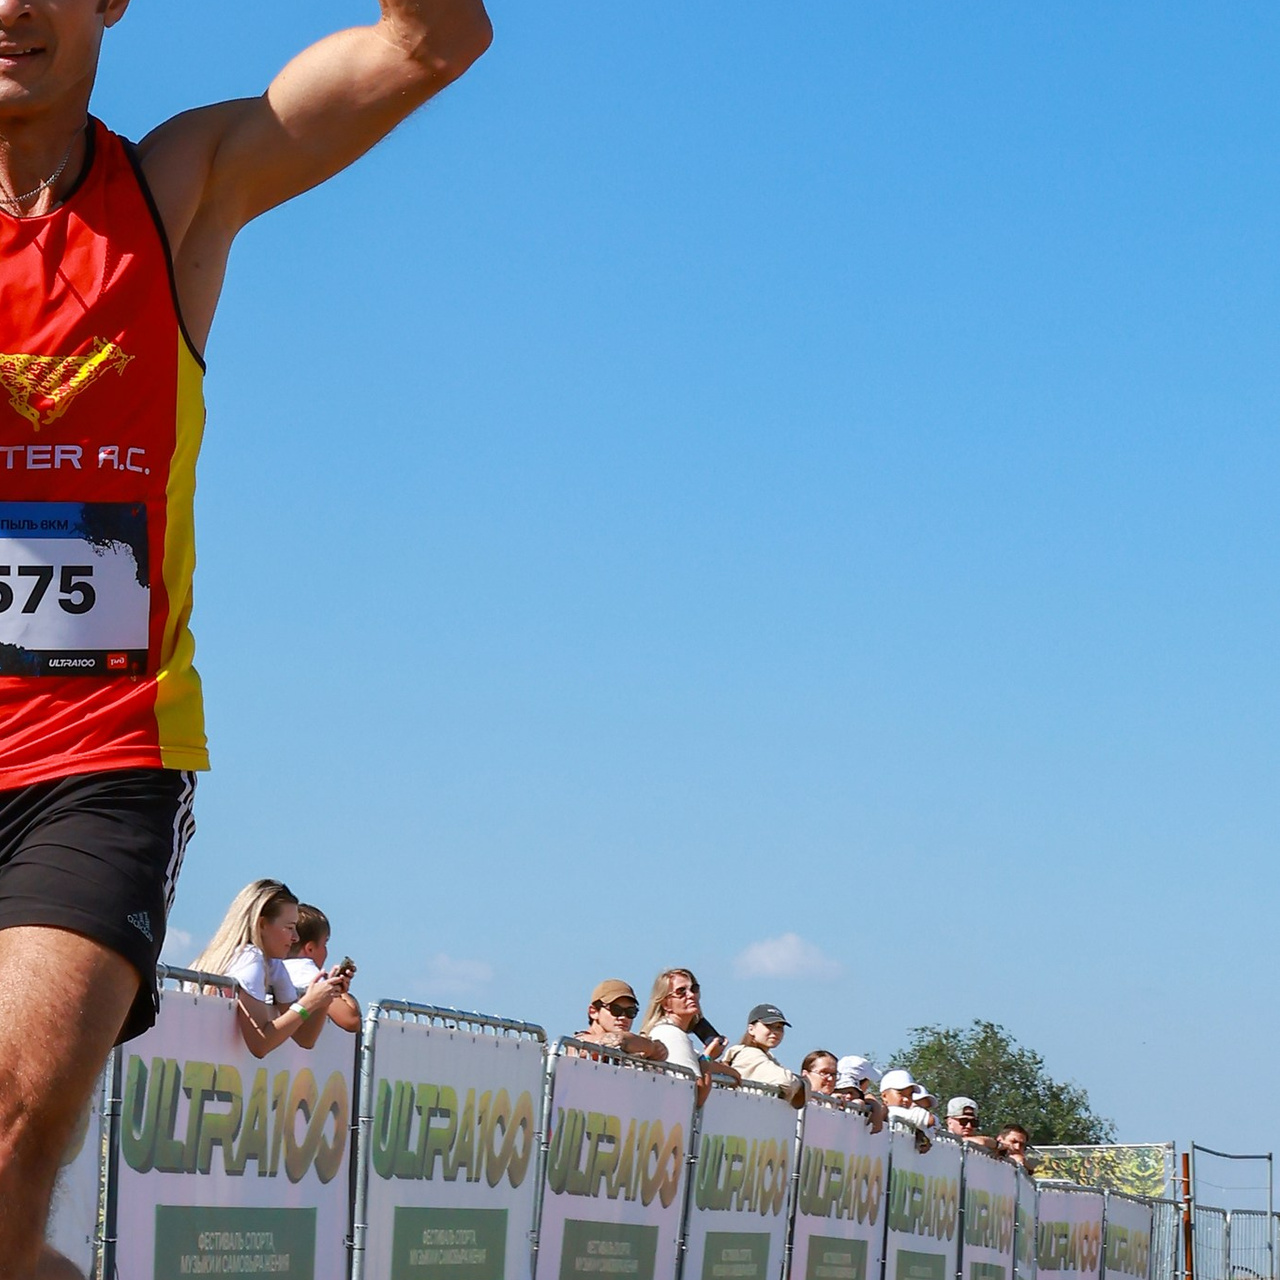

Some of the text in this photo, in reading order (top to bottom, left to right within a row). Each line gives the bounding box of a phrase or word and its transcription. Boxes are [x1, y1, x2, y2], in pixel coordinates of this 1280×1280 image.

[98, 447, 151, 475] A.C.
[0, 519, 39, 531] ПЫЛЬ
[120, 1053, 348, 1185] ULTRA100
[372, 1077, 535, 1189] ULTRA100
[548, 1106, 684, 1210] ULTRA100
